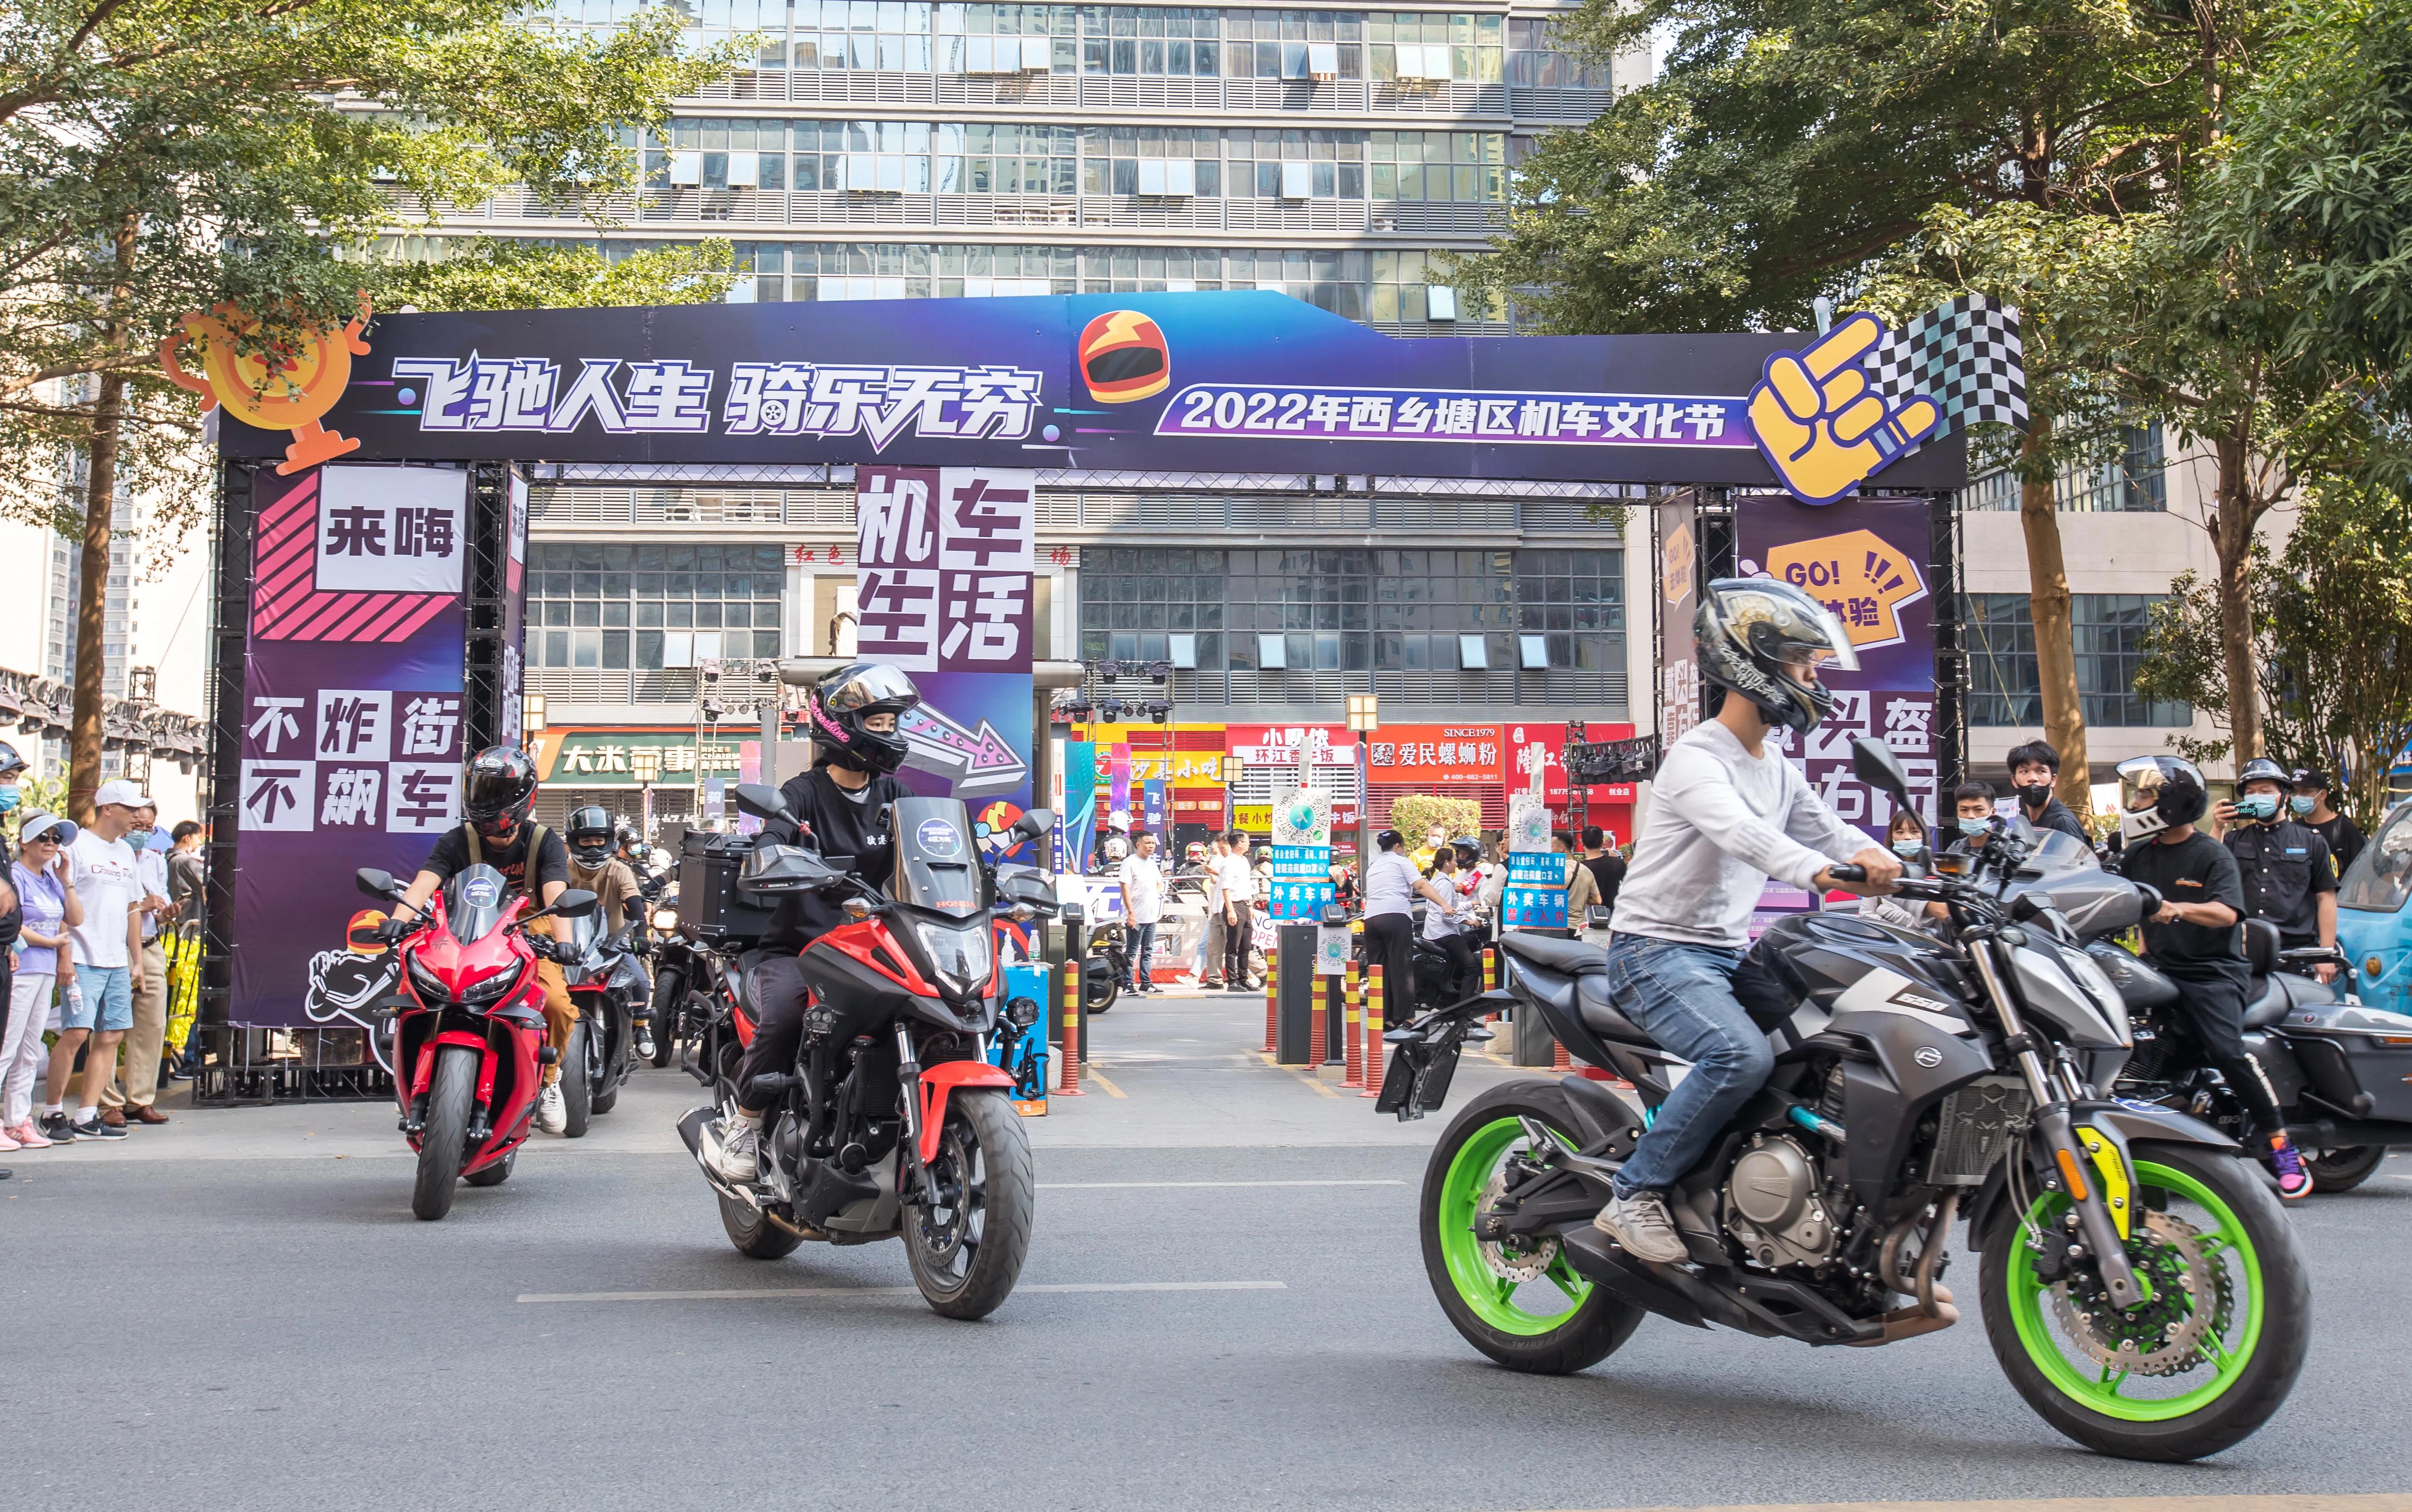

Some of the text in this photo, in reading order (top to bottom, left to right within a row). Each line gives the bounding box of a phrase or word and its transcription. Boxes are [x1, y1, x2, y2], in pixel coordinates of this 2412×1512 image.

[393, 350, 1044, 454] 飞驰人生 骑乐无穷
[1181, 389, 1726, 442] 2022年西乡塘区机车文化节
[325, 506, 454, 558] 来嗨
[857, 475, 1030, 566] 机车
[1786, 561, 1840, 587] GO!
[858, 571, 1027, 660] 生活
[248, 696, 458, 755] 不炸街
[1399, 742, 1497, 766] 爱民螺蛳粉
[246, 767, 453, 827] 不飙车
[1233, 813, 1273, 825] 餐小炒
[935, 900, 977, 909] HONDA
[1273, 885, 1332, 902] 外卖车辆
[1507, 891, 1565, 907] 外卖车辆
[1273, 902, 1315, 916] 禁止入
[1506, 907, 1564, 924] 禁止入内
[1896, 993, 1950, 1012] 650
